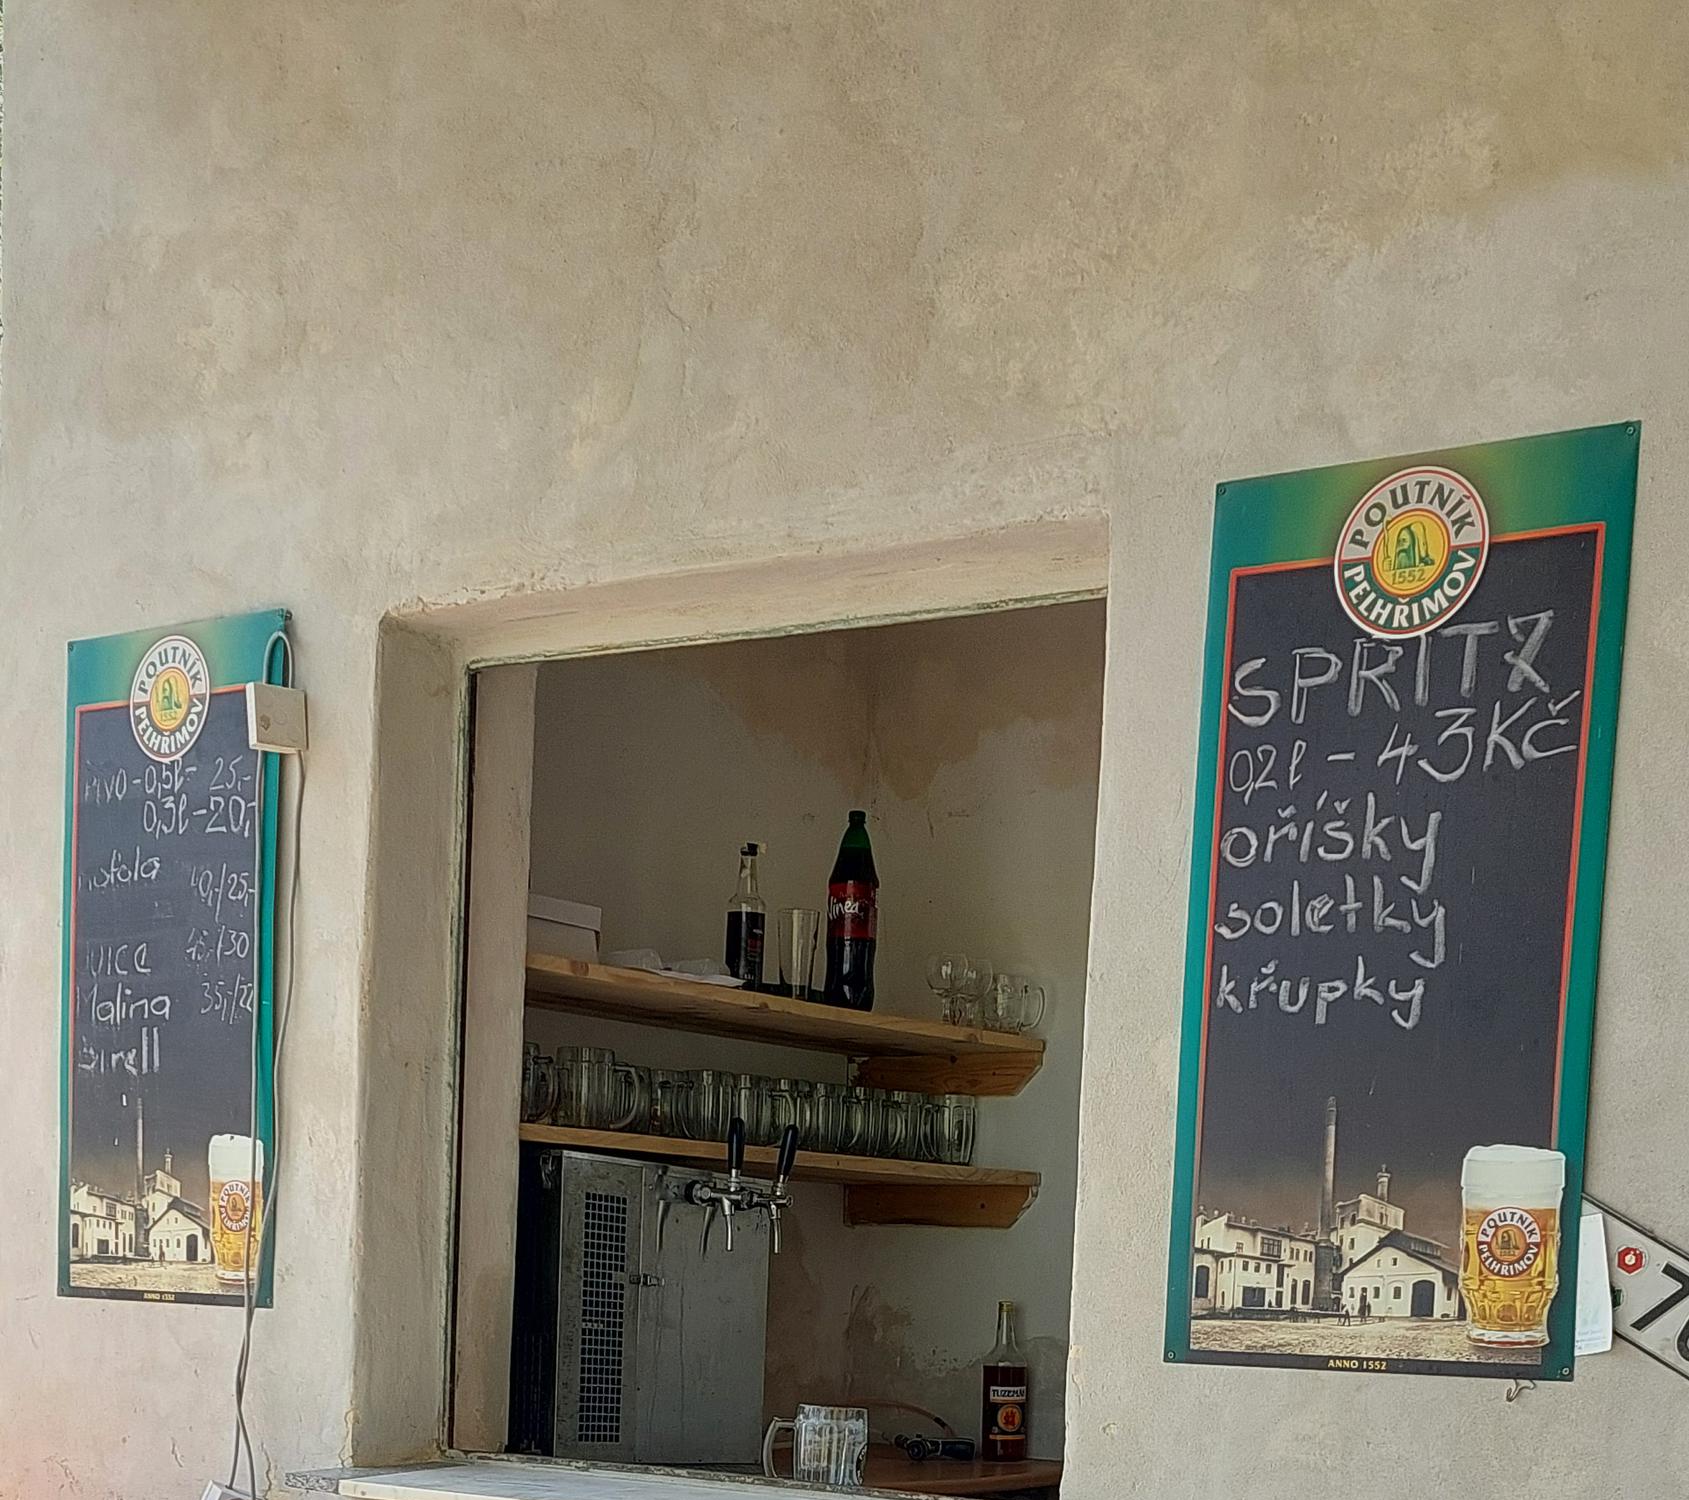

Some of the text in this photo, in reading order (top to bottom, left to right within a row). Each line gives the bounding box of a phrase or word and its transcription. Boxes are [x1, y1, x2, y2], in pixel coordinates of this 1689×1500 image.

[1349, 480, 1476, 550] POUTNÍK
[1344, 550, 1476, 628] PELHŘIMOV
[1392, 569, 1426, 585] 1552
[138, 646, 203, 695] POUTNÍK
[1228, 610, 1553, 727] SPRITZ
[135, 698, 203, 754] PELHŘIMOV
[1221, 790, 1442, 894] oříšky
[1215, 874, 1445, 968] soletky
[1217, 956, 1426, 1030] křupky
[1481, 1211, 1538, 1238] POUTNÍK
[1479, 1245, 1538, 1276] PELHŘIMOV
[1328, 1359, 1386, 1370] ANNO 1552
